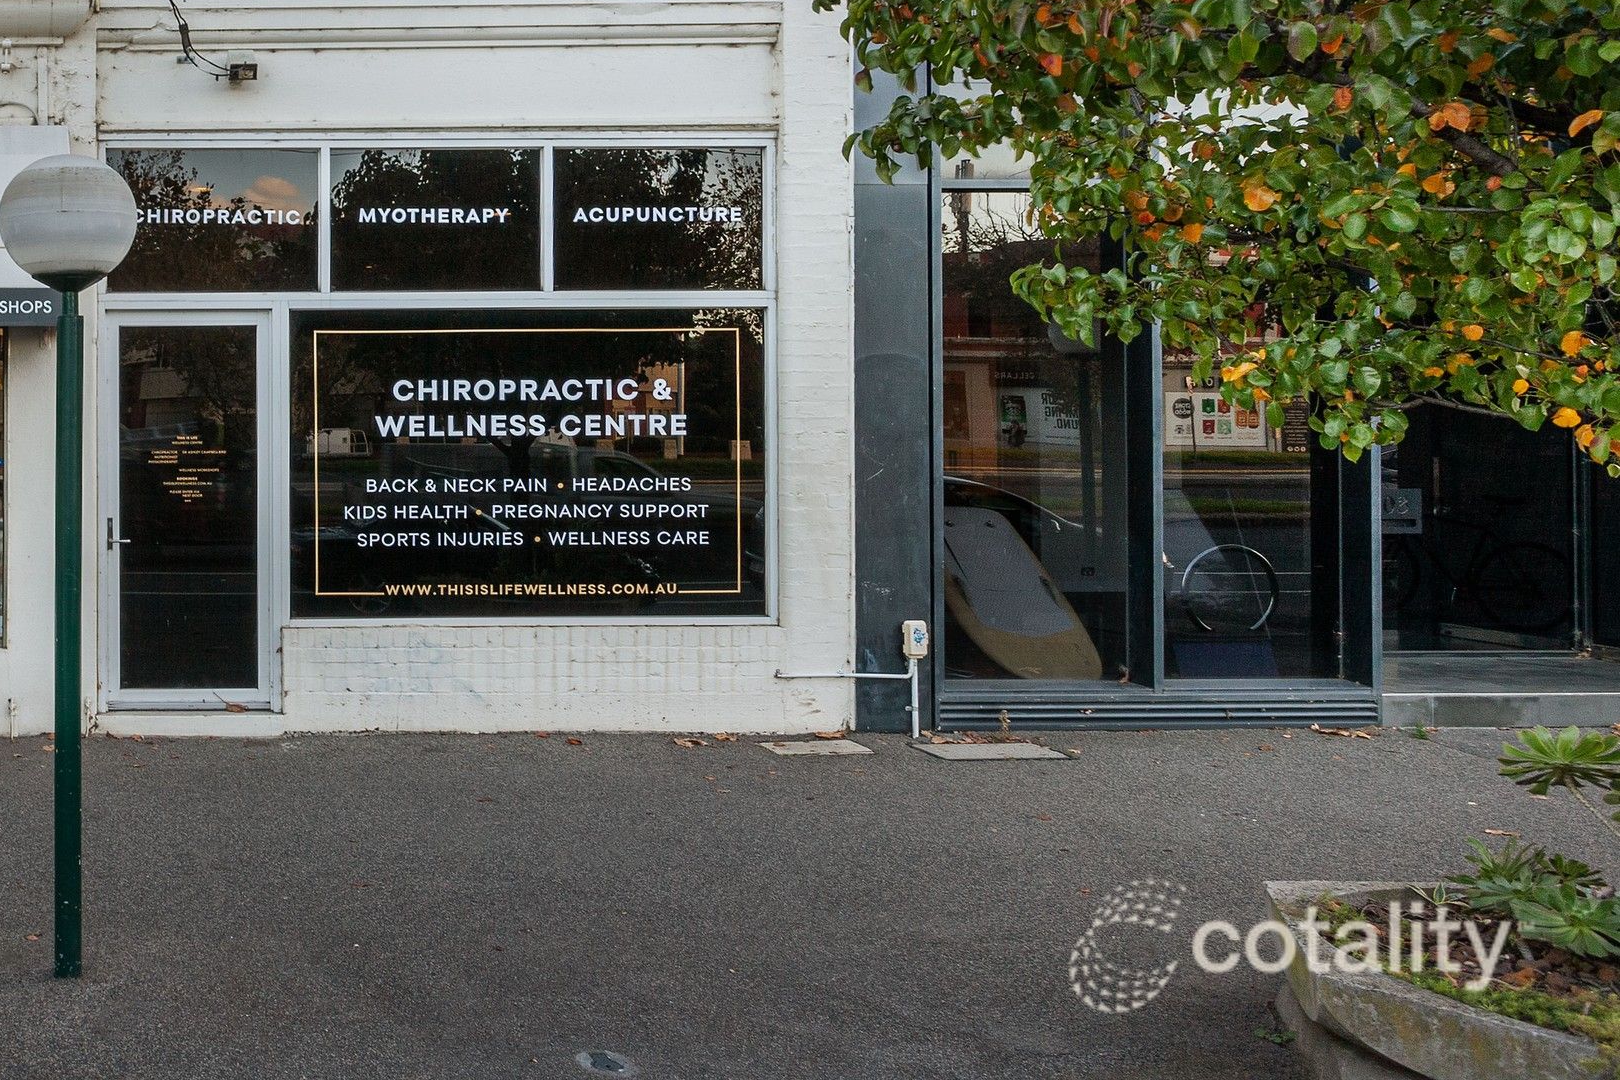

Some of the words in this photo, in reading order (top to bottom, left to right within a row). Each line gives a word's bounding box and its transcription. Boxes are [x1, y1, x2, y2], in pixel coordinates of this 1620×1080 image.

[359, 207, 509, 224] MYOTHERAPY
[573, 206, 742, 223] ACUPUNCTURE
[392, 378, 639, 402] CHIROPRACTIC
[652, 378, 673, 400] &
[375, 414, 546, 437] WELLNESS
[559, 414, 688, 437] CENTRE
[366, 478, 418, 493] BACK
[425, 479, 437, 493] &
[444, 478, 496, 493] NECK
[503, 478, 547, 492] PAIN
[572, 477, 691, 492] HEADACHES
[344, 505, 387, 520] KIDS
[394, 505, 468, 519] HEALTH
[492, 504, 613, 519] PREGNANCY
[619, 504, 709, 518] SUPPORT
[357, 532, 430, 547] SPORTS
[437, 531, 524, 546] INJURIES
[549, 531, 650, 546] WELLNESS
[657, 530, 709, 545] CARE
[385, 582, 678, 596] WWW.THISISLIFEWELLNESS.COM.AU
